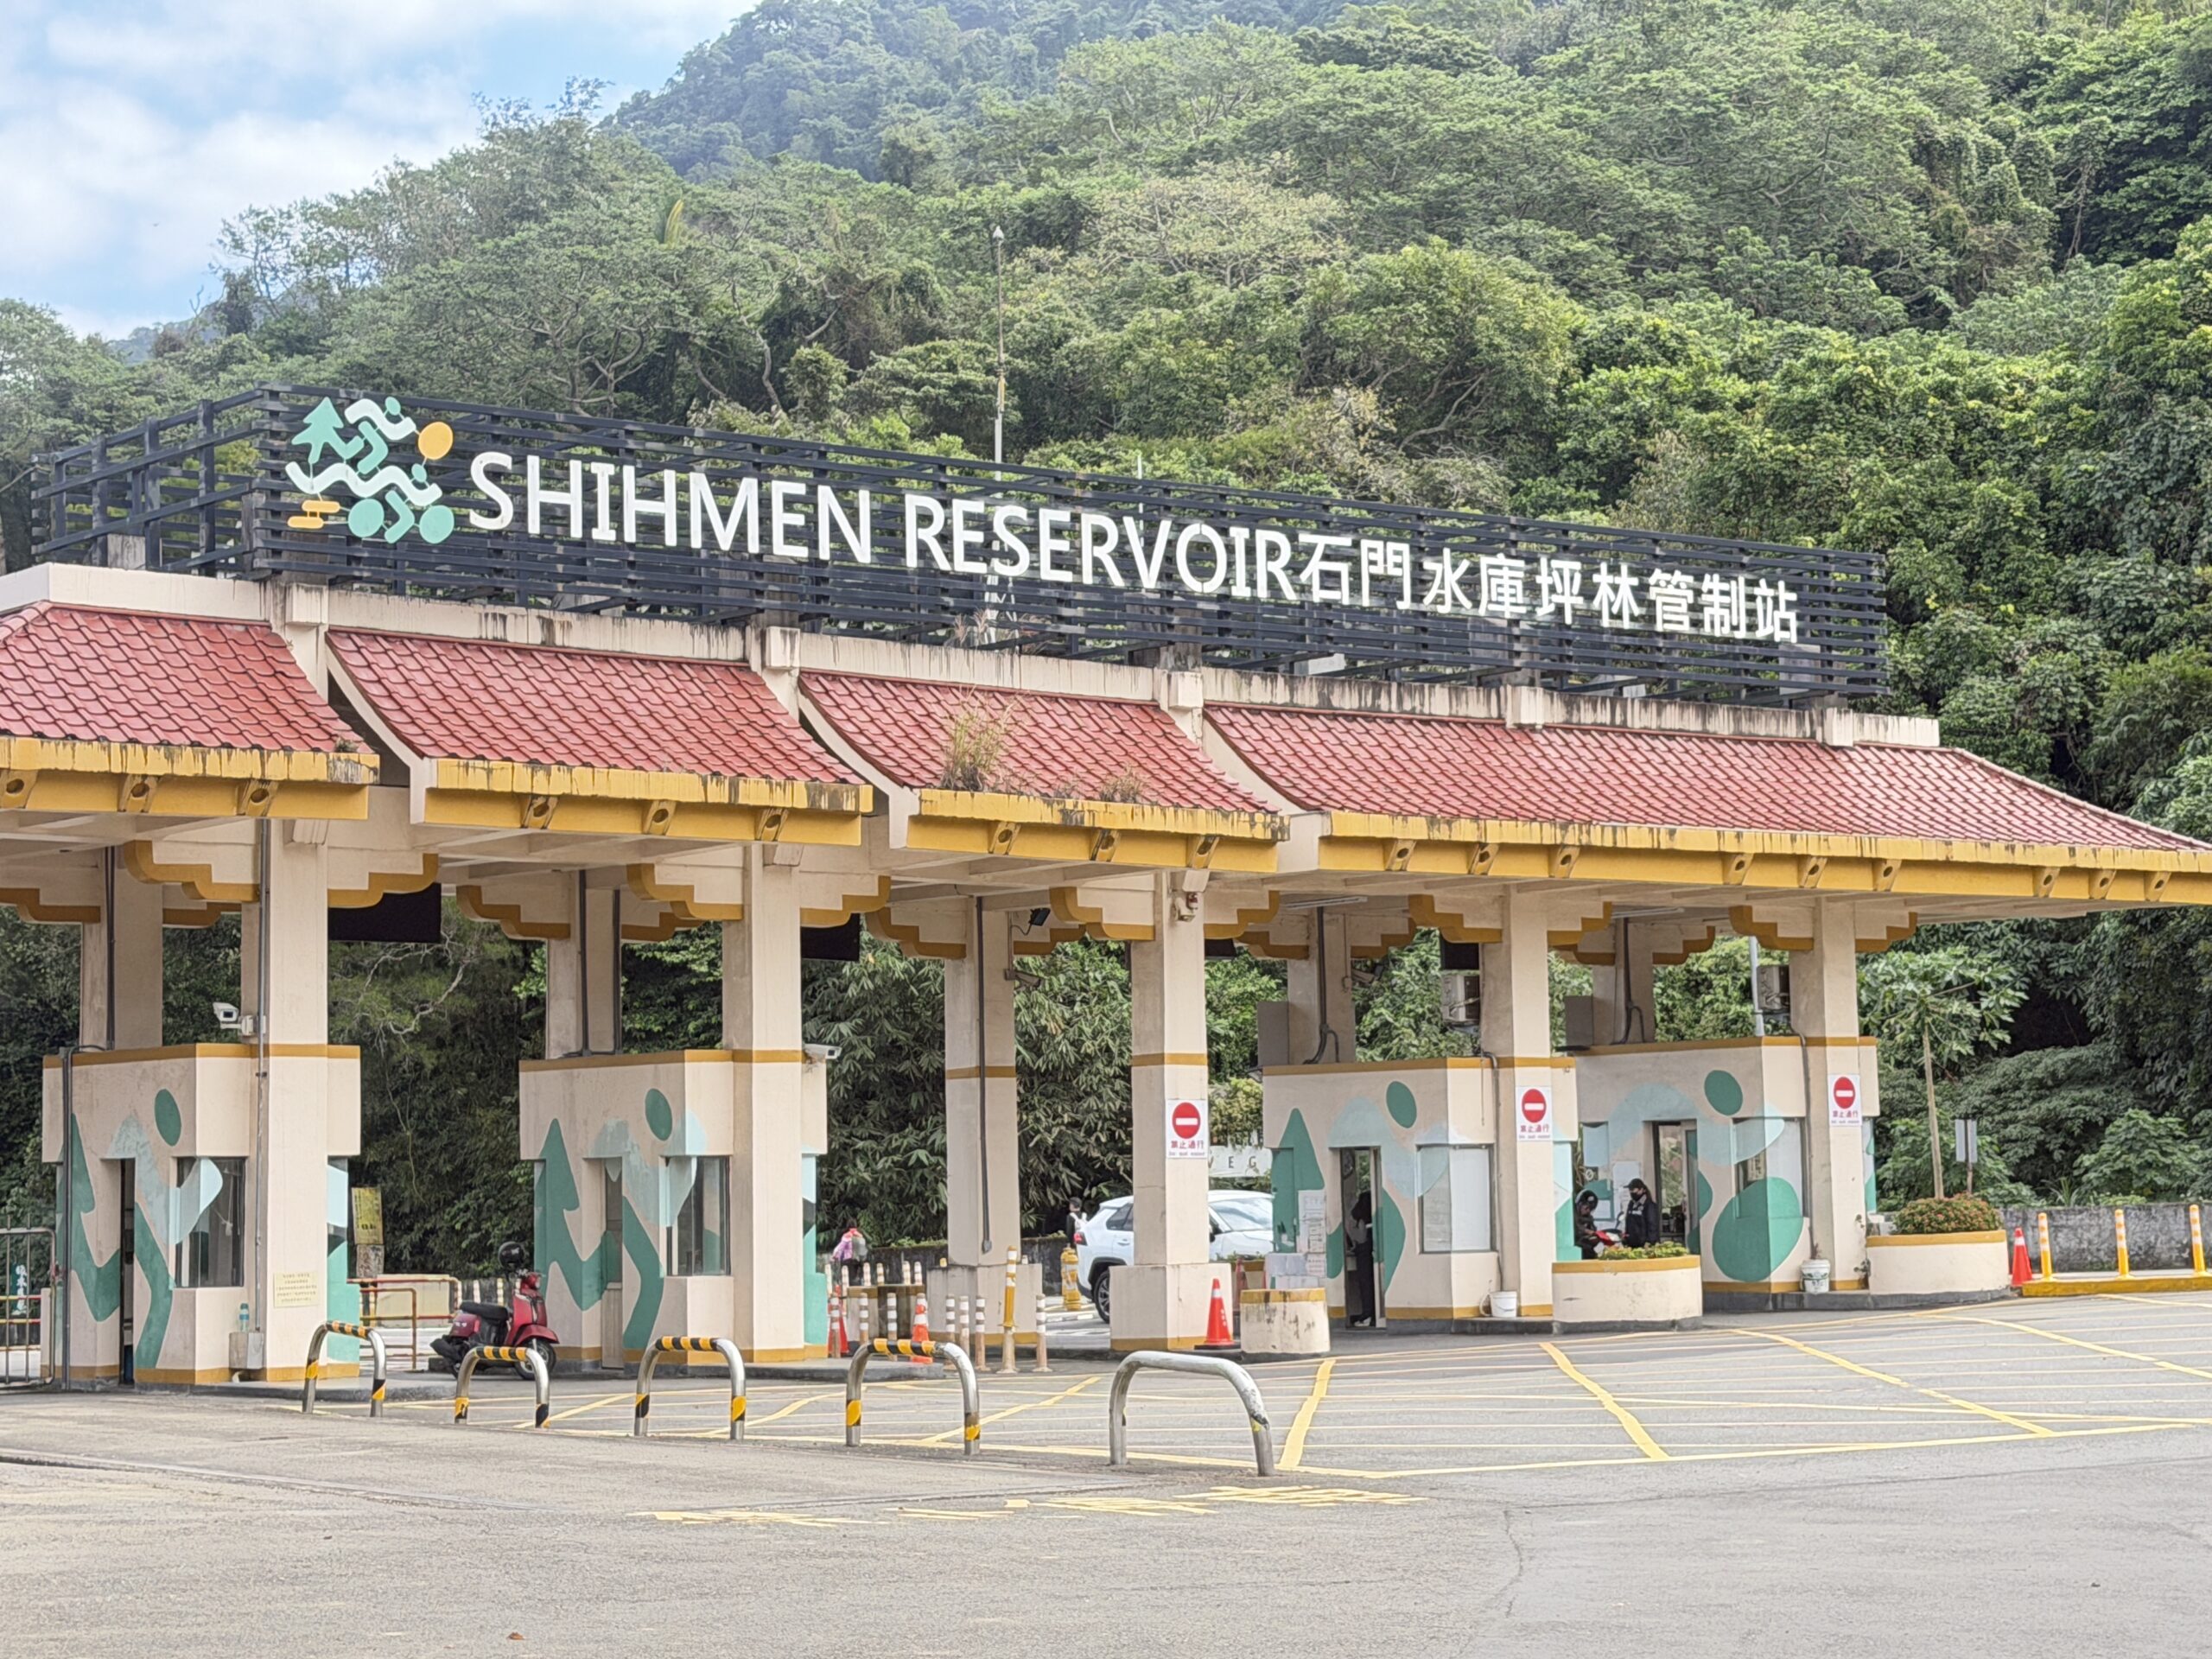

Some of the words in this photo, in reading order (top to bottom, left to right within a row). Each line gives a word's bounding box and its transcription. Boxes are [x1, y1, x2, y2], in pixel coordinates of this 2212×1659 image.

[468, 450, 872, 564] SHIHMEN
[904, 493, 1298, 601] RESERVOIR
[1298, 532, 1798, 645] 石門水庫坪林管制站
